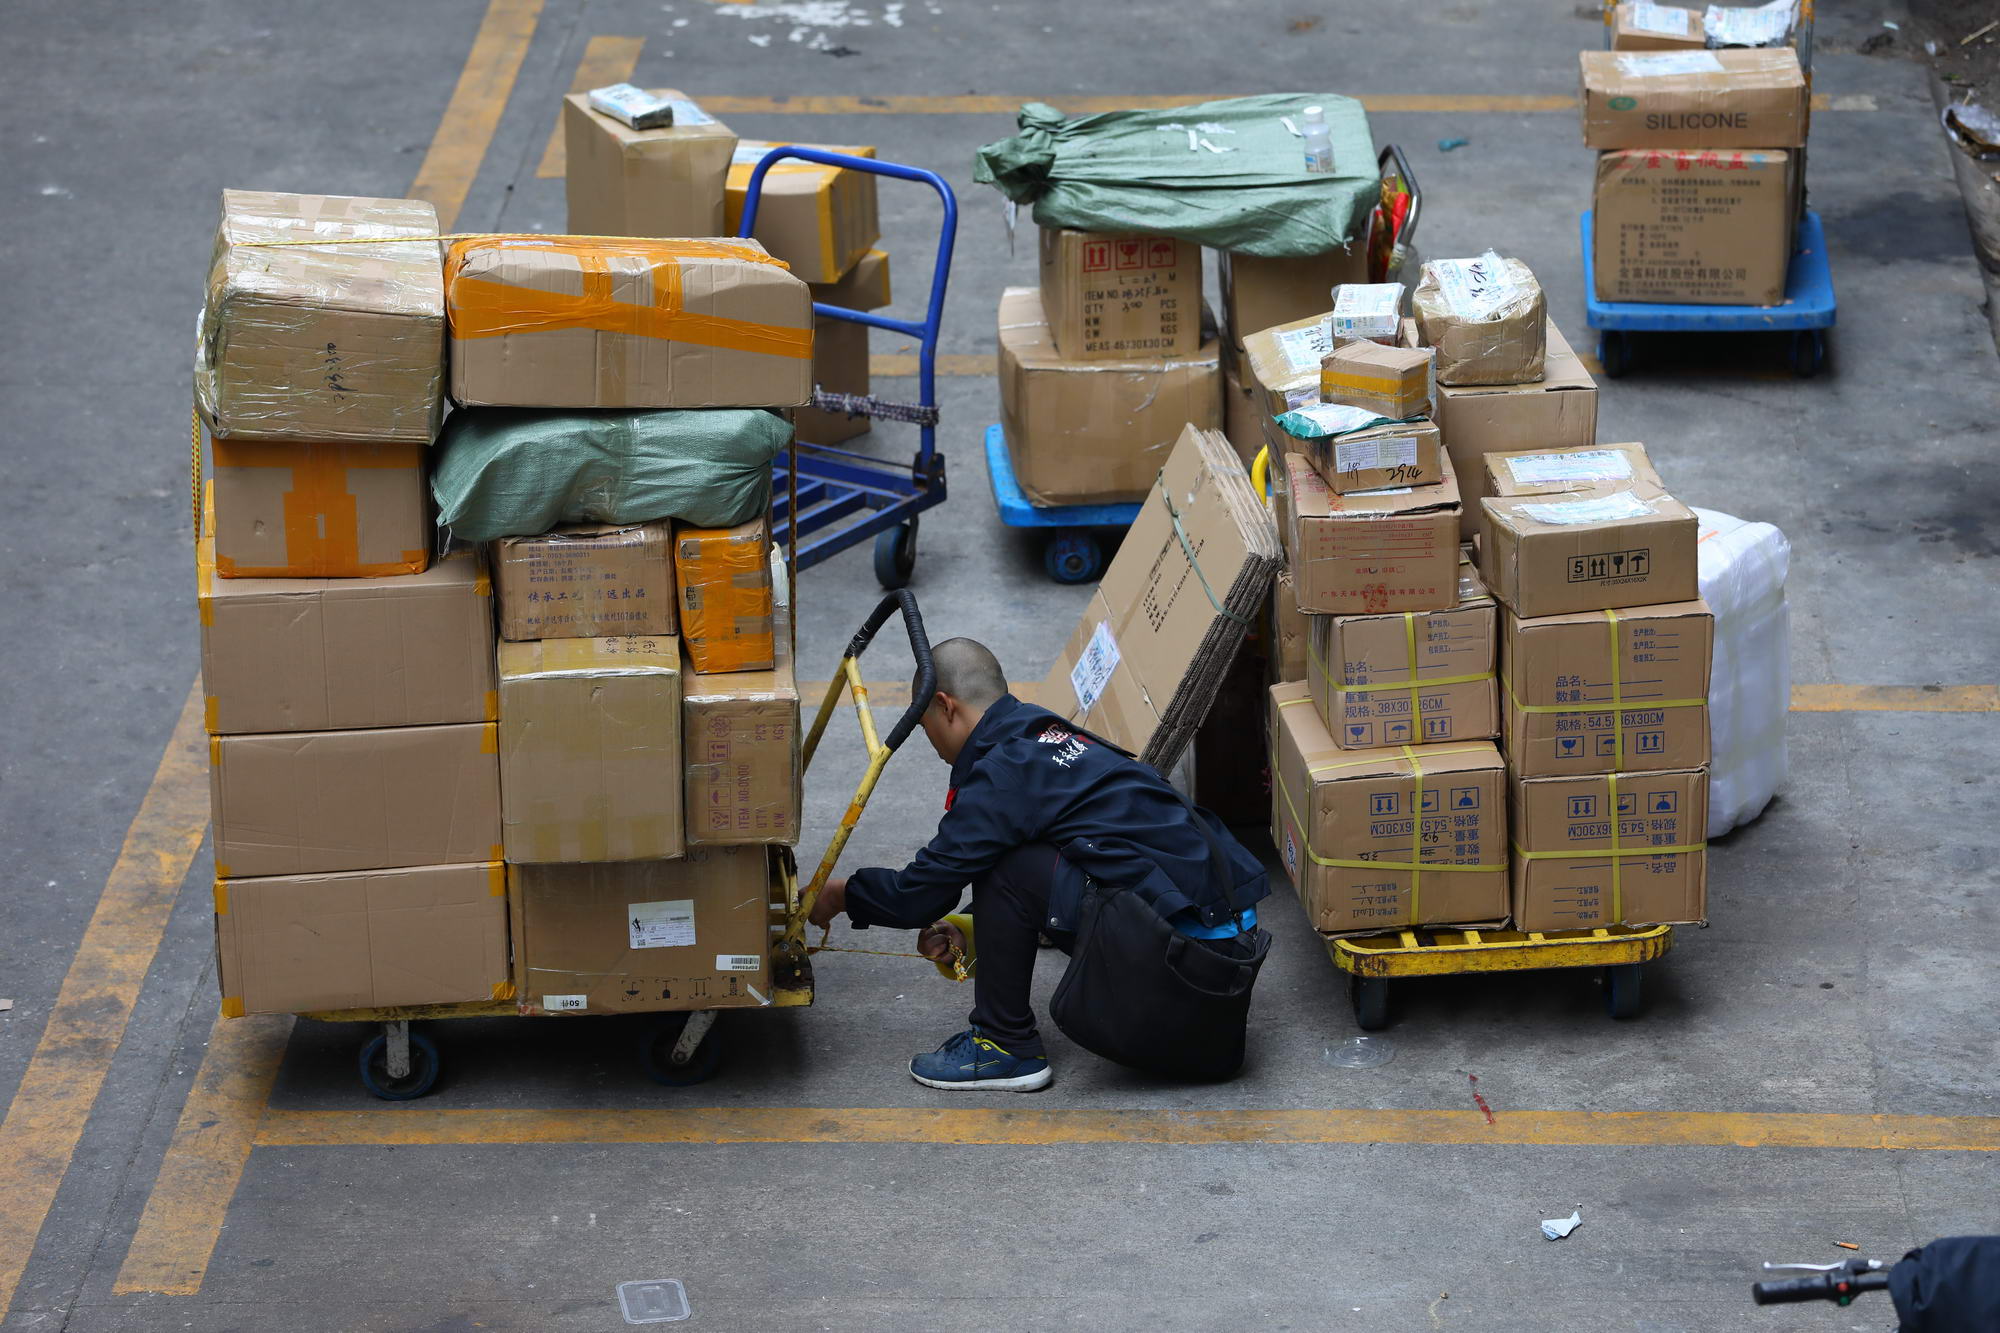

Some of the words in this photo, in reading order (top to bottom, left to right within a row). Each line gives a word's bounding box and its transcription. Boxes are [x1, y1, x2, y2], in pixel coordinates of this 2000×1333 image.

[1646, 112, 1748, 130] SILICONE
[1085, 291, 1104, 301] ITEM
[1160, 299, 1177, 309] PCS
[1160, 312, 1177, 322] KGS
[1160, 324, 1177, 335] KGS
[1574, 560, 1584, 574] 5
[1344, 661, 1373, 673] 品名:
[1556, 675, 1586, 688] 品名:
[1556, 689, 1586, 703] 数量:
[755, 723, 767, 741] PCS
[773, 723, 785, 741] KGS
[738, 808, 750, 829] ITEM
[1645, 861, 1677, 874] 品名:
